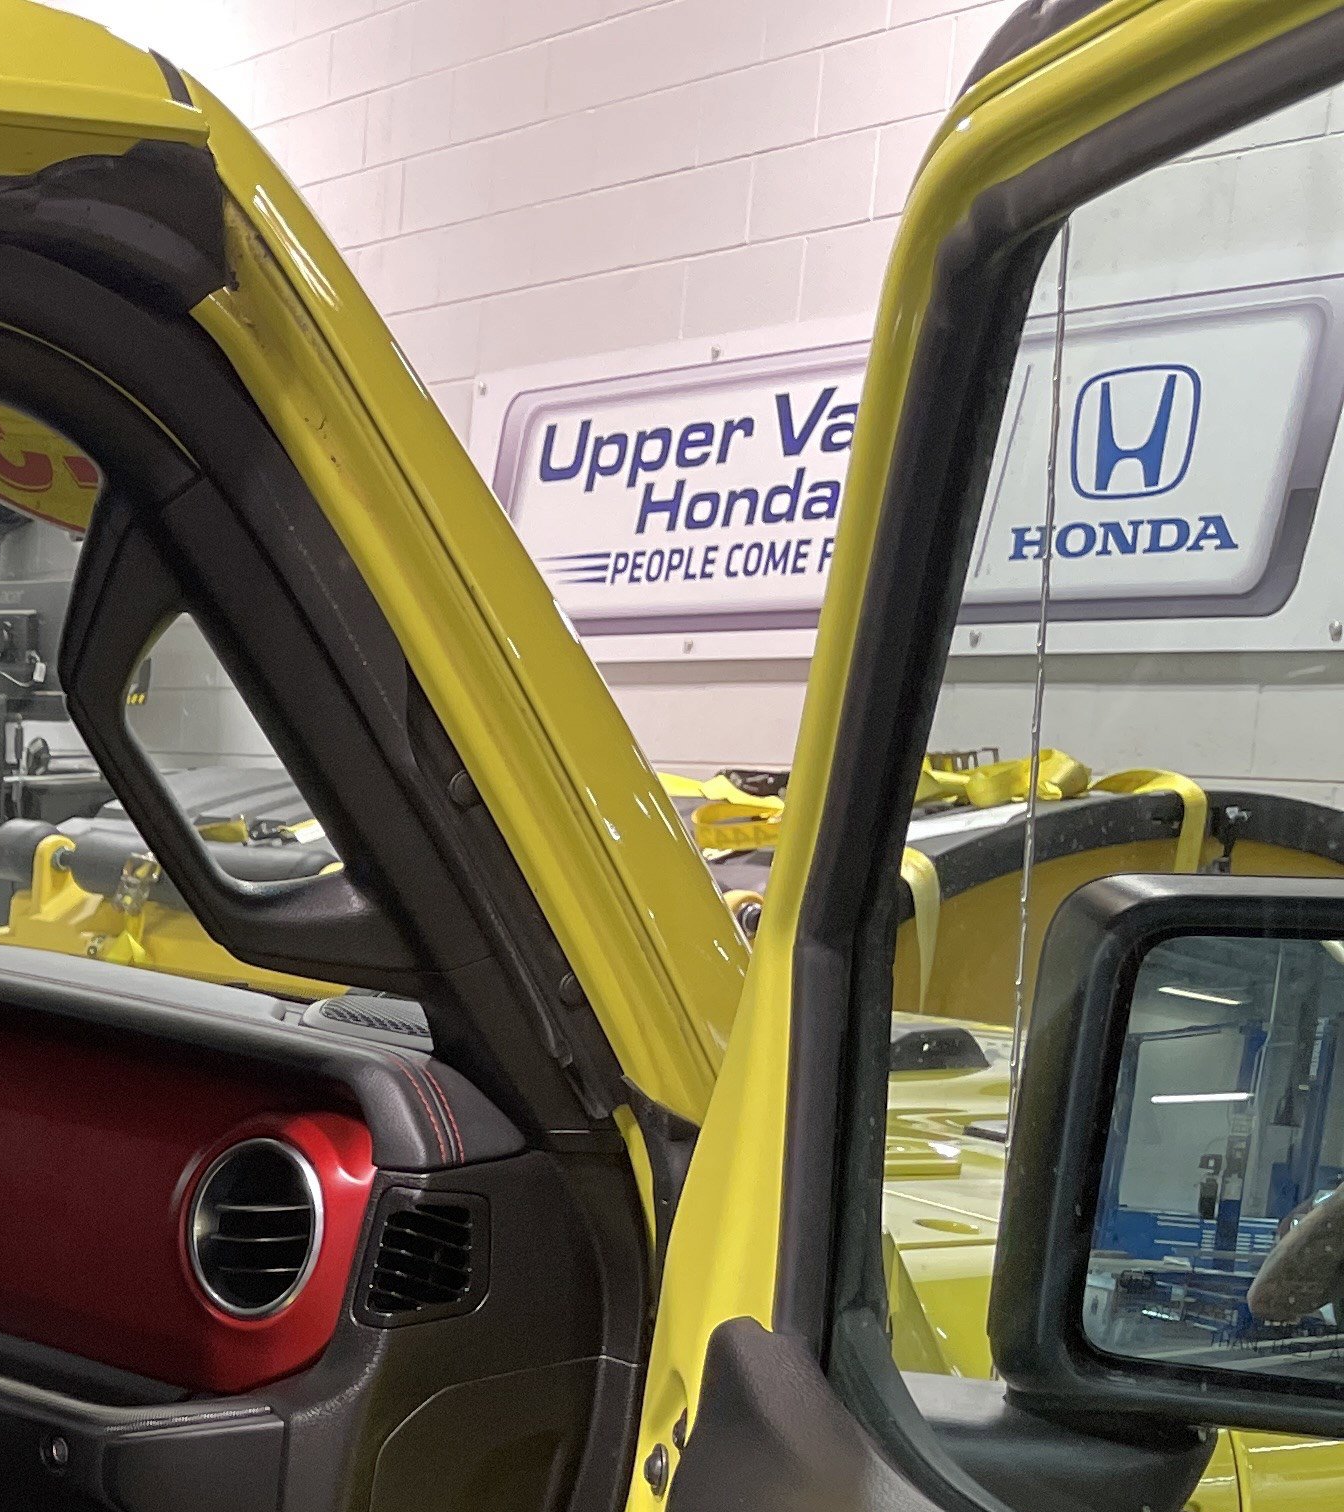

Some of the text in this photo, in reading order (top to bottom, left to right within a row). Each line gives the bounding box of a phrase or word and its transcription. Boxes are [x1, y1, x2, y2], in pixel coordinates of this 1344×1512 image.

[539, 417, 754, 491] Upper
[635, 468, 841, 534] Honda
[611, 545, 718, 585] PEOPLE
[725, 539, 811, 578] COME
[1008, 515, 1238, 561] HONDA
